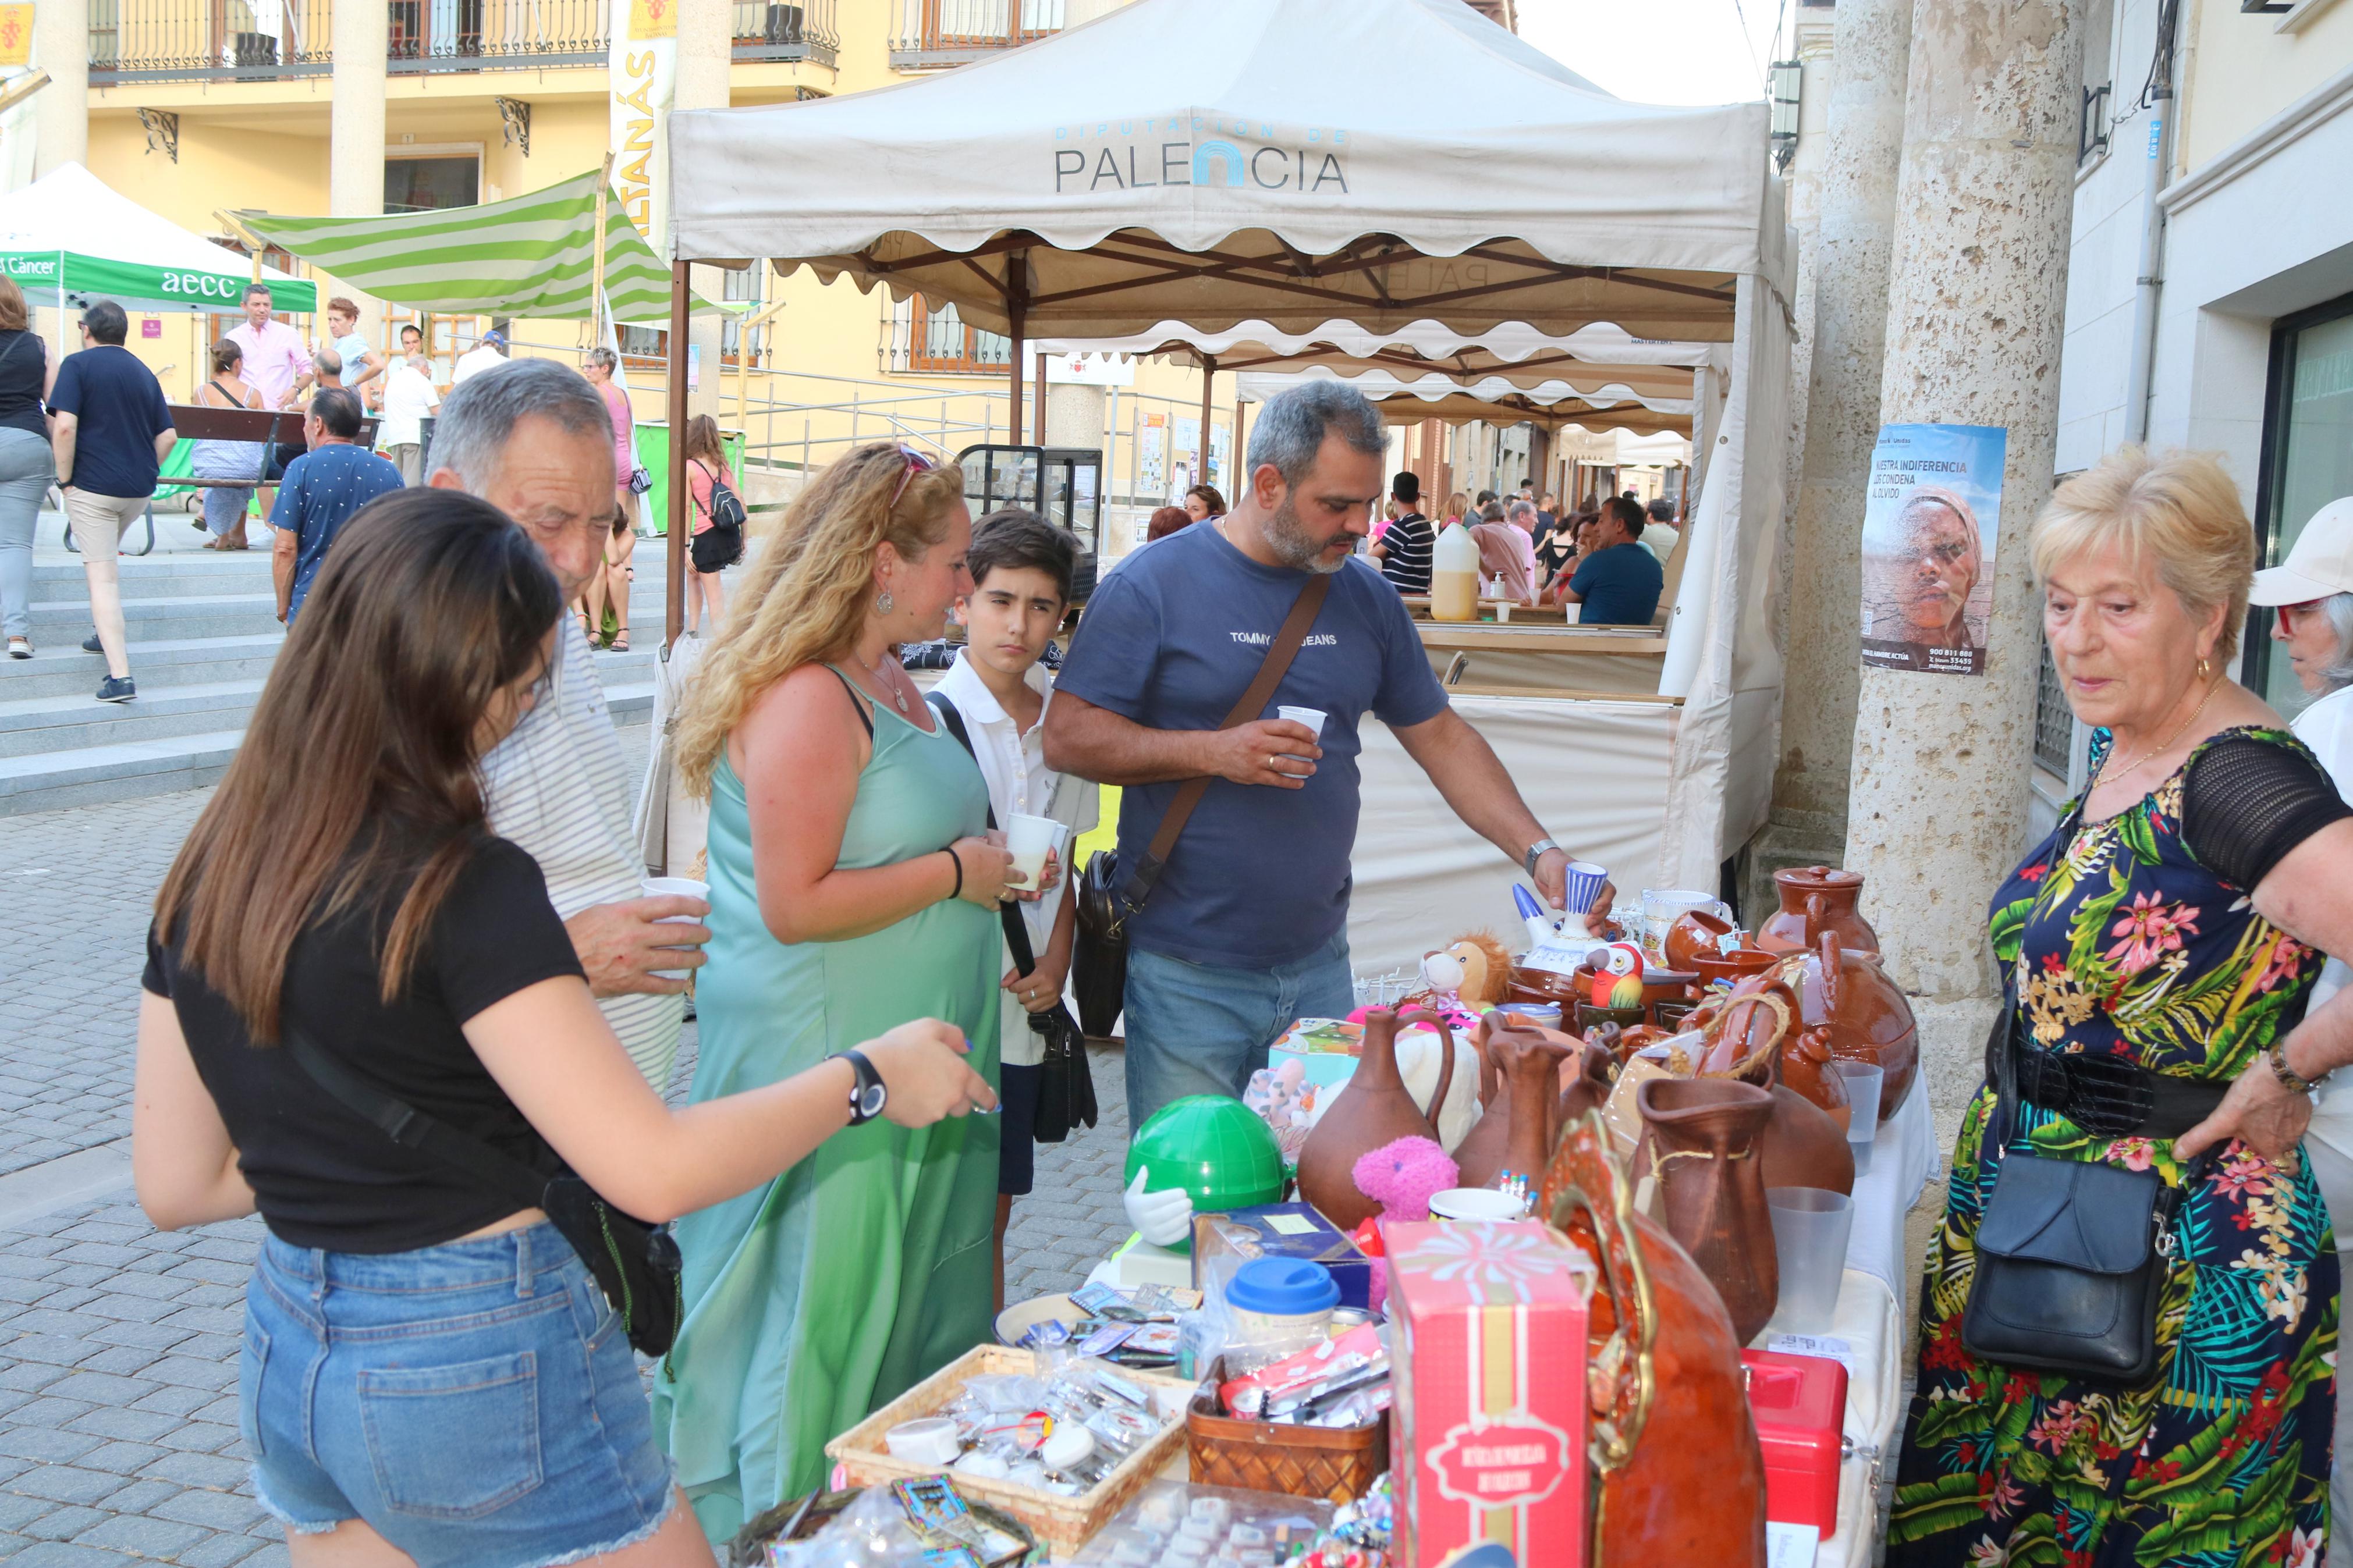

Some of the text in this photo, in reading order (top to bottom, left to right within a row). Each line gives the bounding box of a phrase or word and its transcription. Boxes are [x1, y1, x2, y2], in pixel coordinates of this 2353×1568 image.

[1056, 118, 1346, 144] DIPUTACIÓN DE
[9, 257, 56, 274] Cáncer
[161, 272, 235, 298] aecc
[1876, 460, 1967, 473] NUESTRA INDIFERENCIA
[1873, 474, 1915, 485] LOS CONDENA
[1872, 488, 1900, 499] AL OLVIDO
[1229, 632, 1337, 646] TOMMY JEANS
[1873, 650, 1891, 659] HAMBRE
[1891, 652, 1909, 660] ACTÚA
